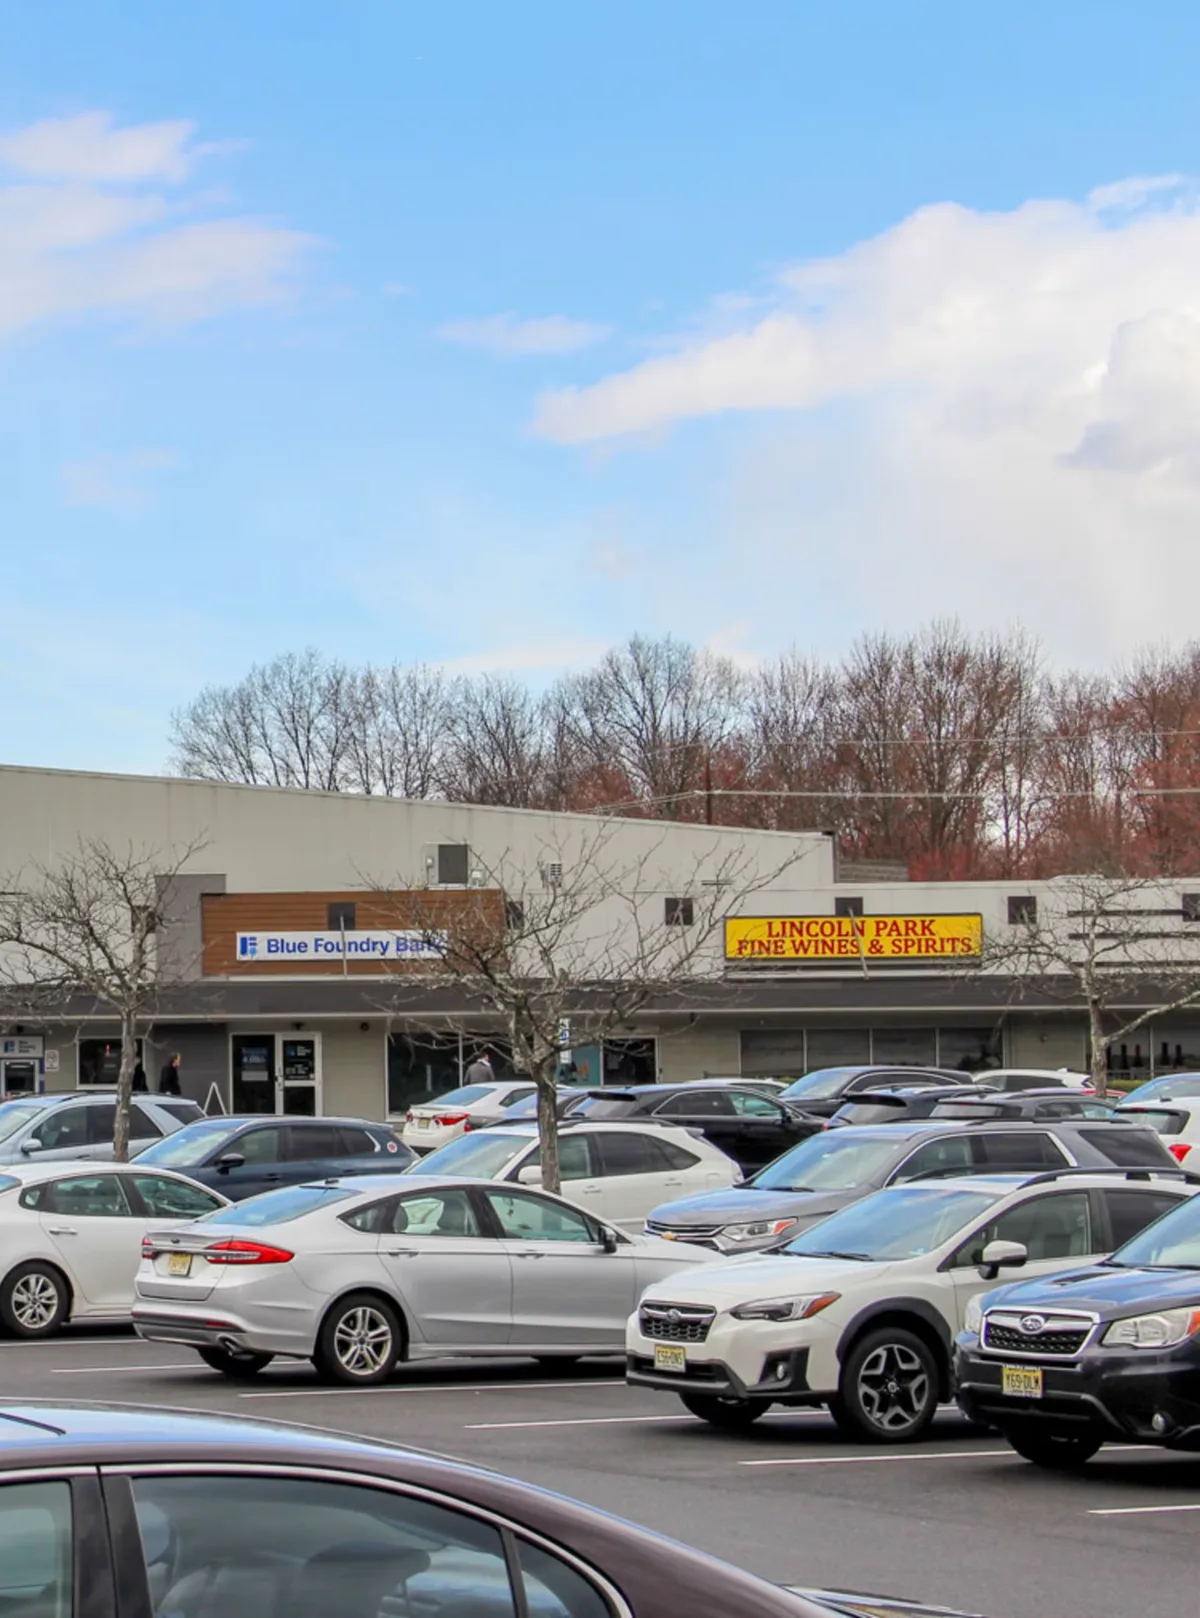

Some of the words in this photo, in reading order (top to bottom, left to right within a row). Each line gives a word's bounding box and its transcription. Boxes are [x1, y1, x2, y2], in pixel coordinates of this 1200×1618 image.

[767, 920, 865, 938] LINCOLN
[874, 919, 936, 937] PARK
[267, 938, 308, 953] Blue
[313, 937, 390, 956] Foundry
[737, 939, 785, 955] FINE
[791, 938, 861, 955] WINES
[868, 939, 884, 955] &
[891, 937, 972, 955] SPIRITS
